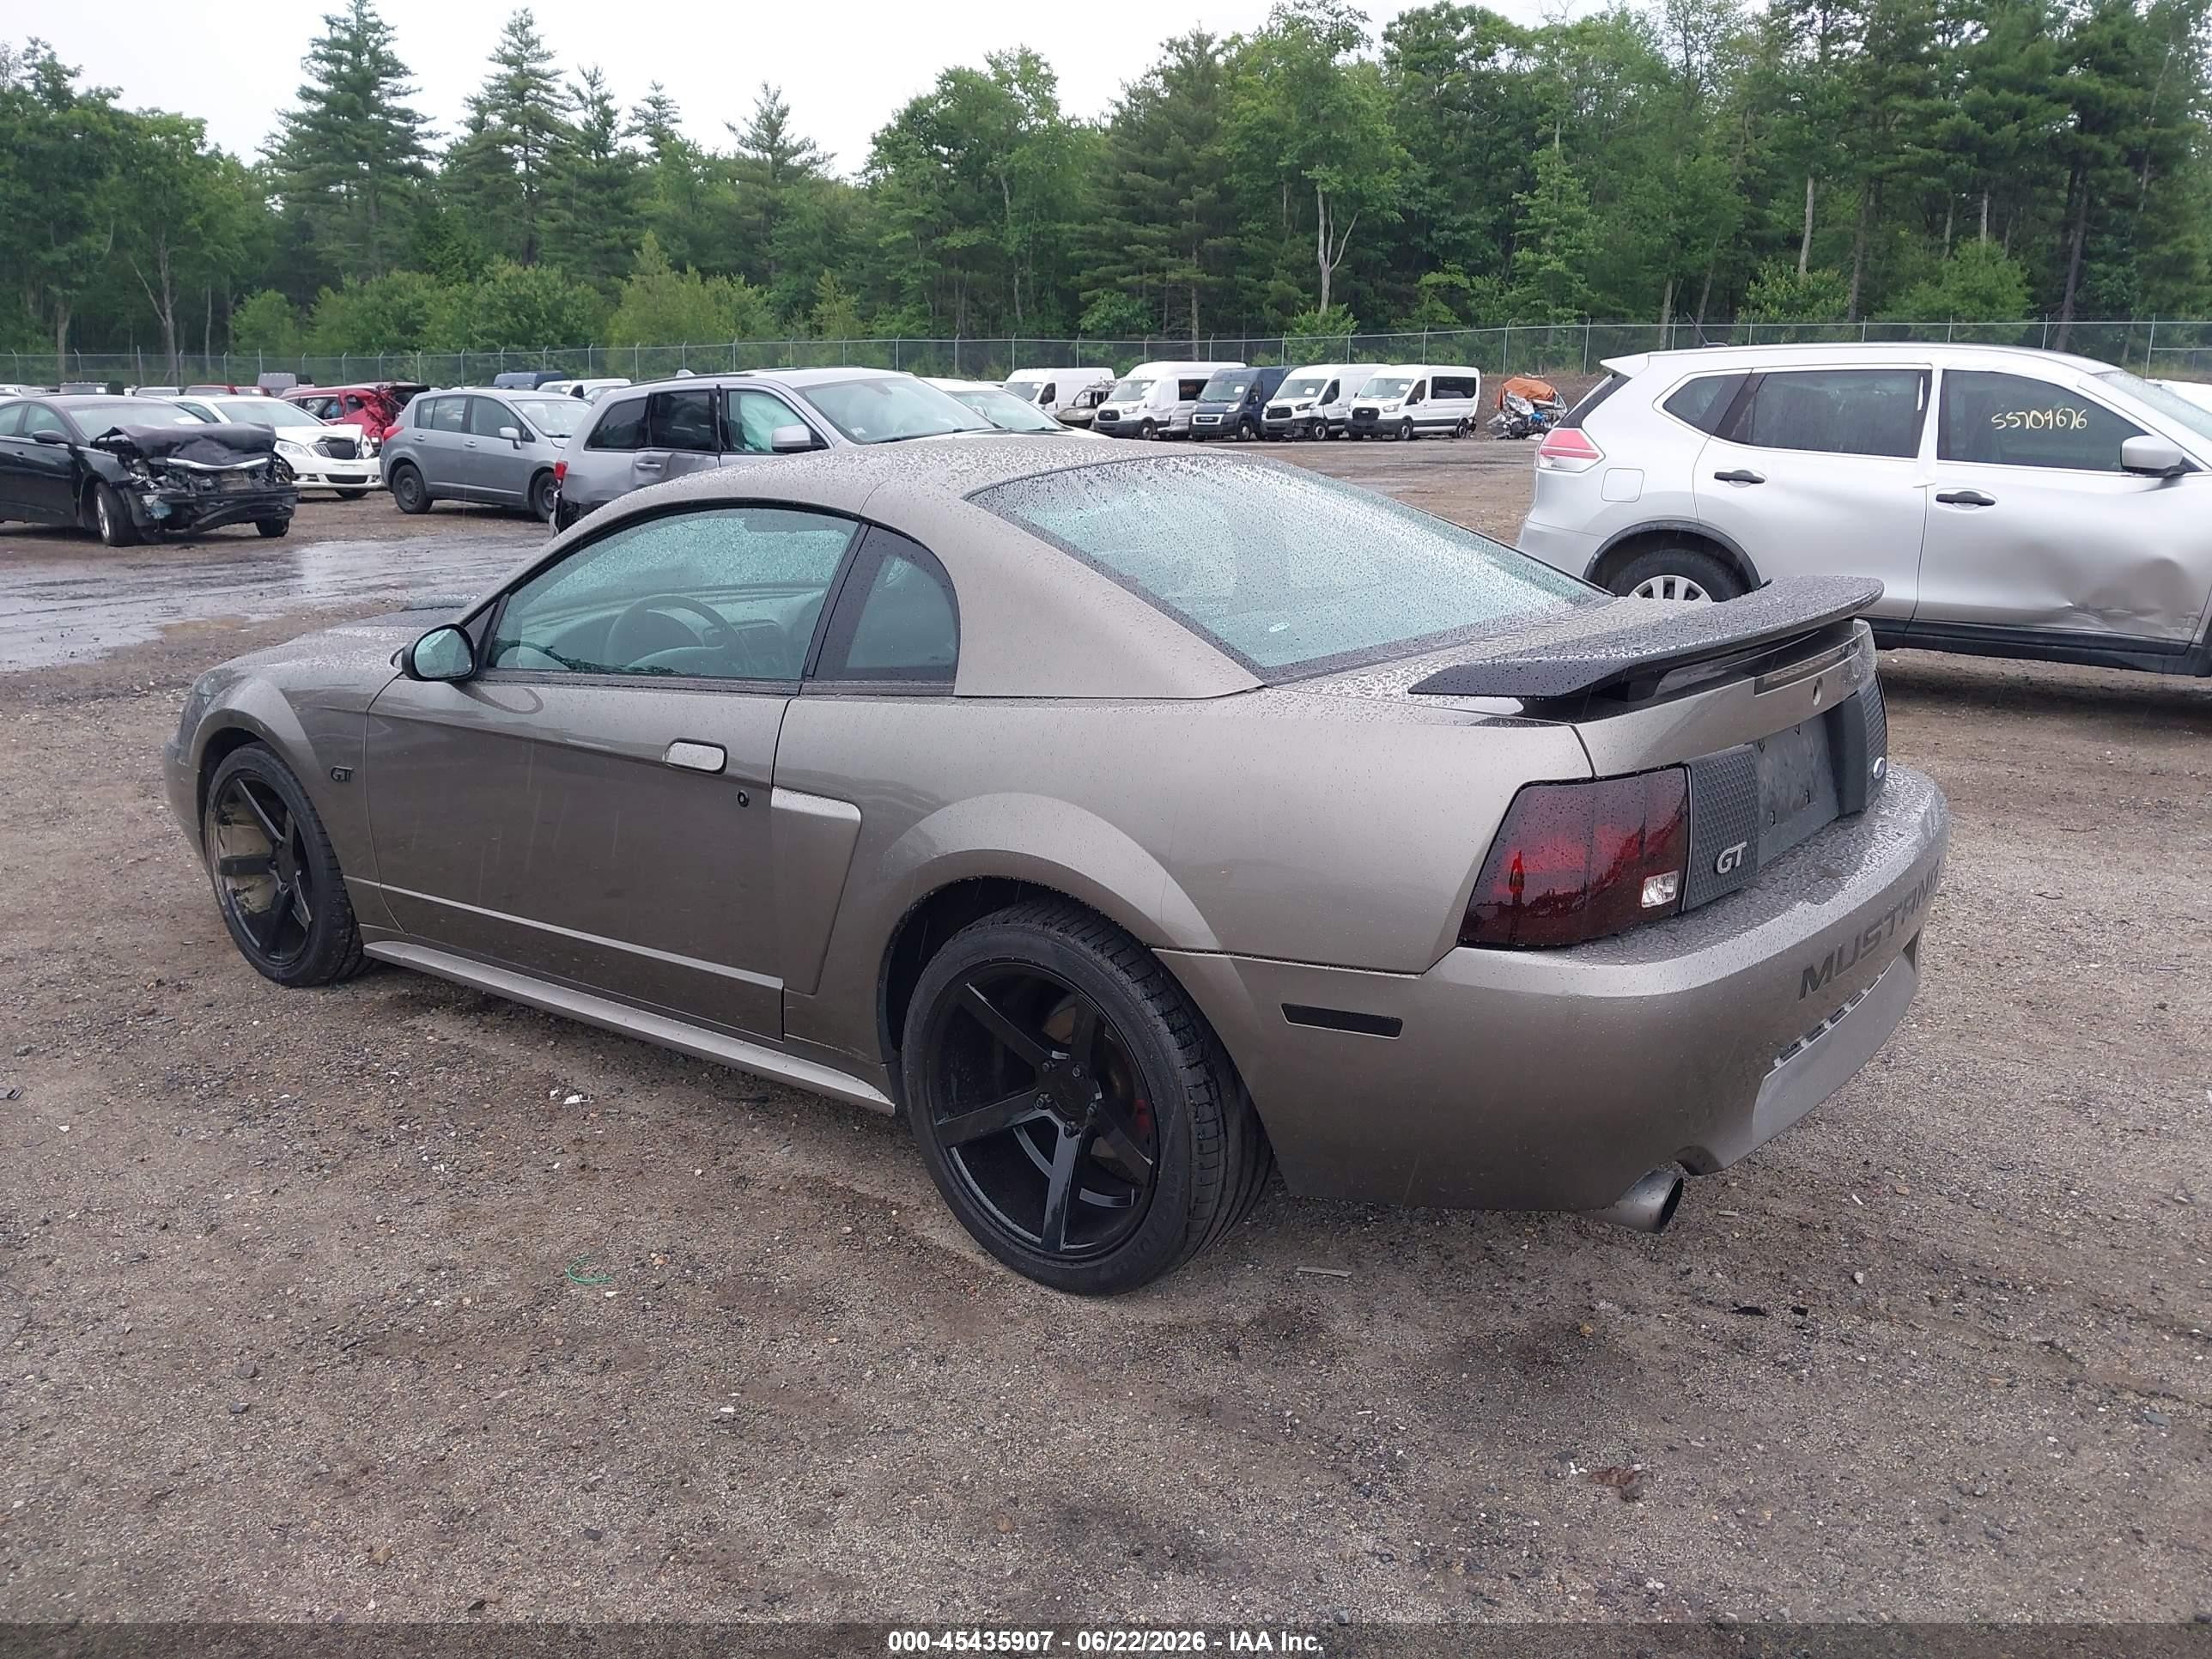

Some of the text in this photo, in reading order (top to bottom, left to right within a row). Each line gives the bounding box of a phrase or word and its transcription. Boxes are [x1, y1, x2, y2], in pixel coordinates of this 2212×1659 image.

[330, 765, 354, 783] GT
[1717, 841, 1747, 874] GT
[1797, 858, 1940, 1003] MUSTANG
